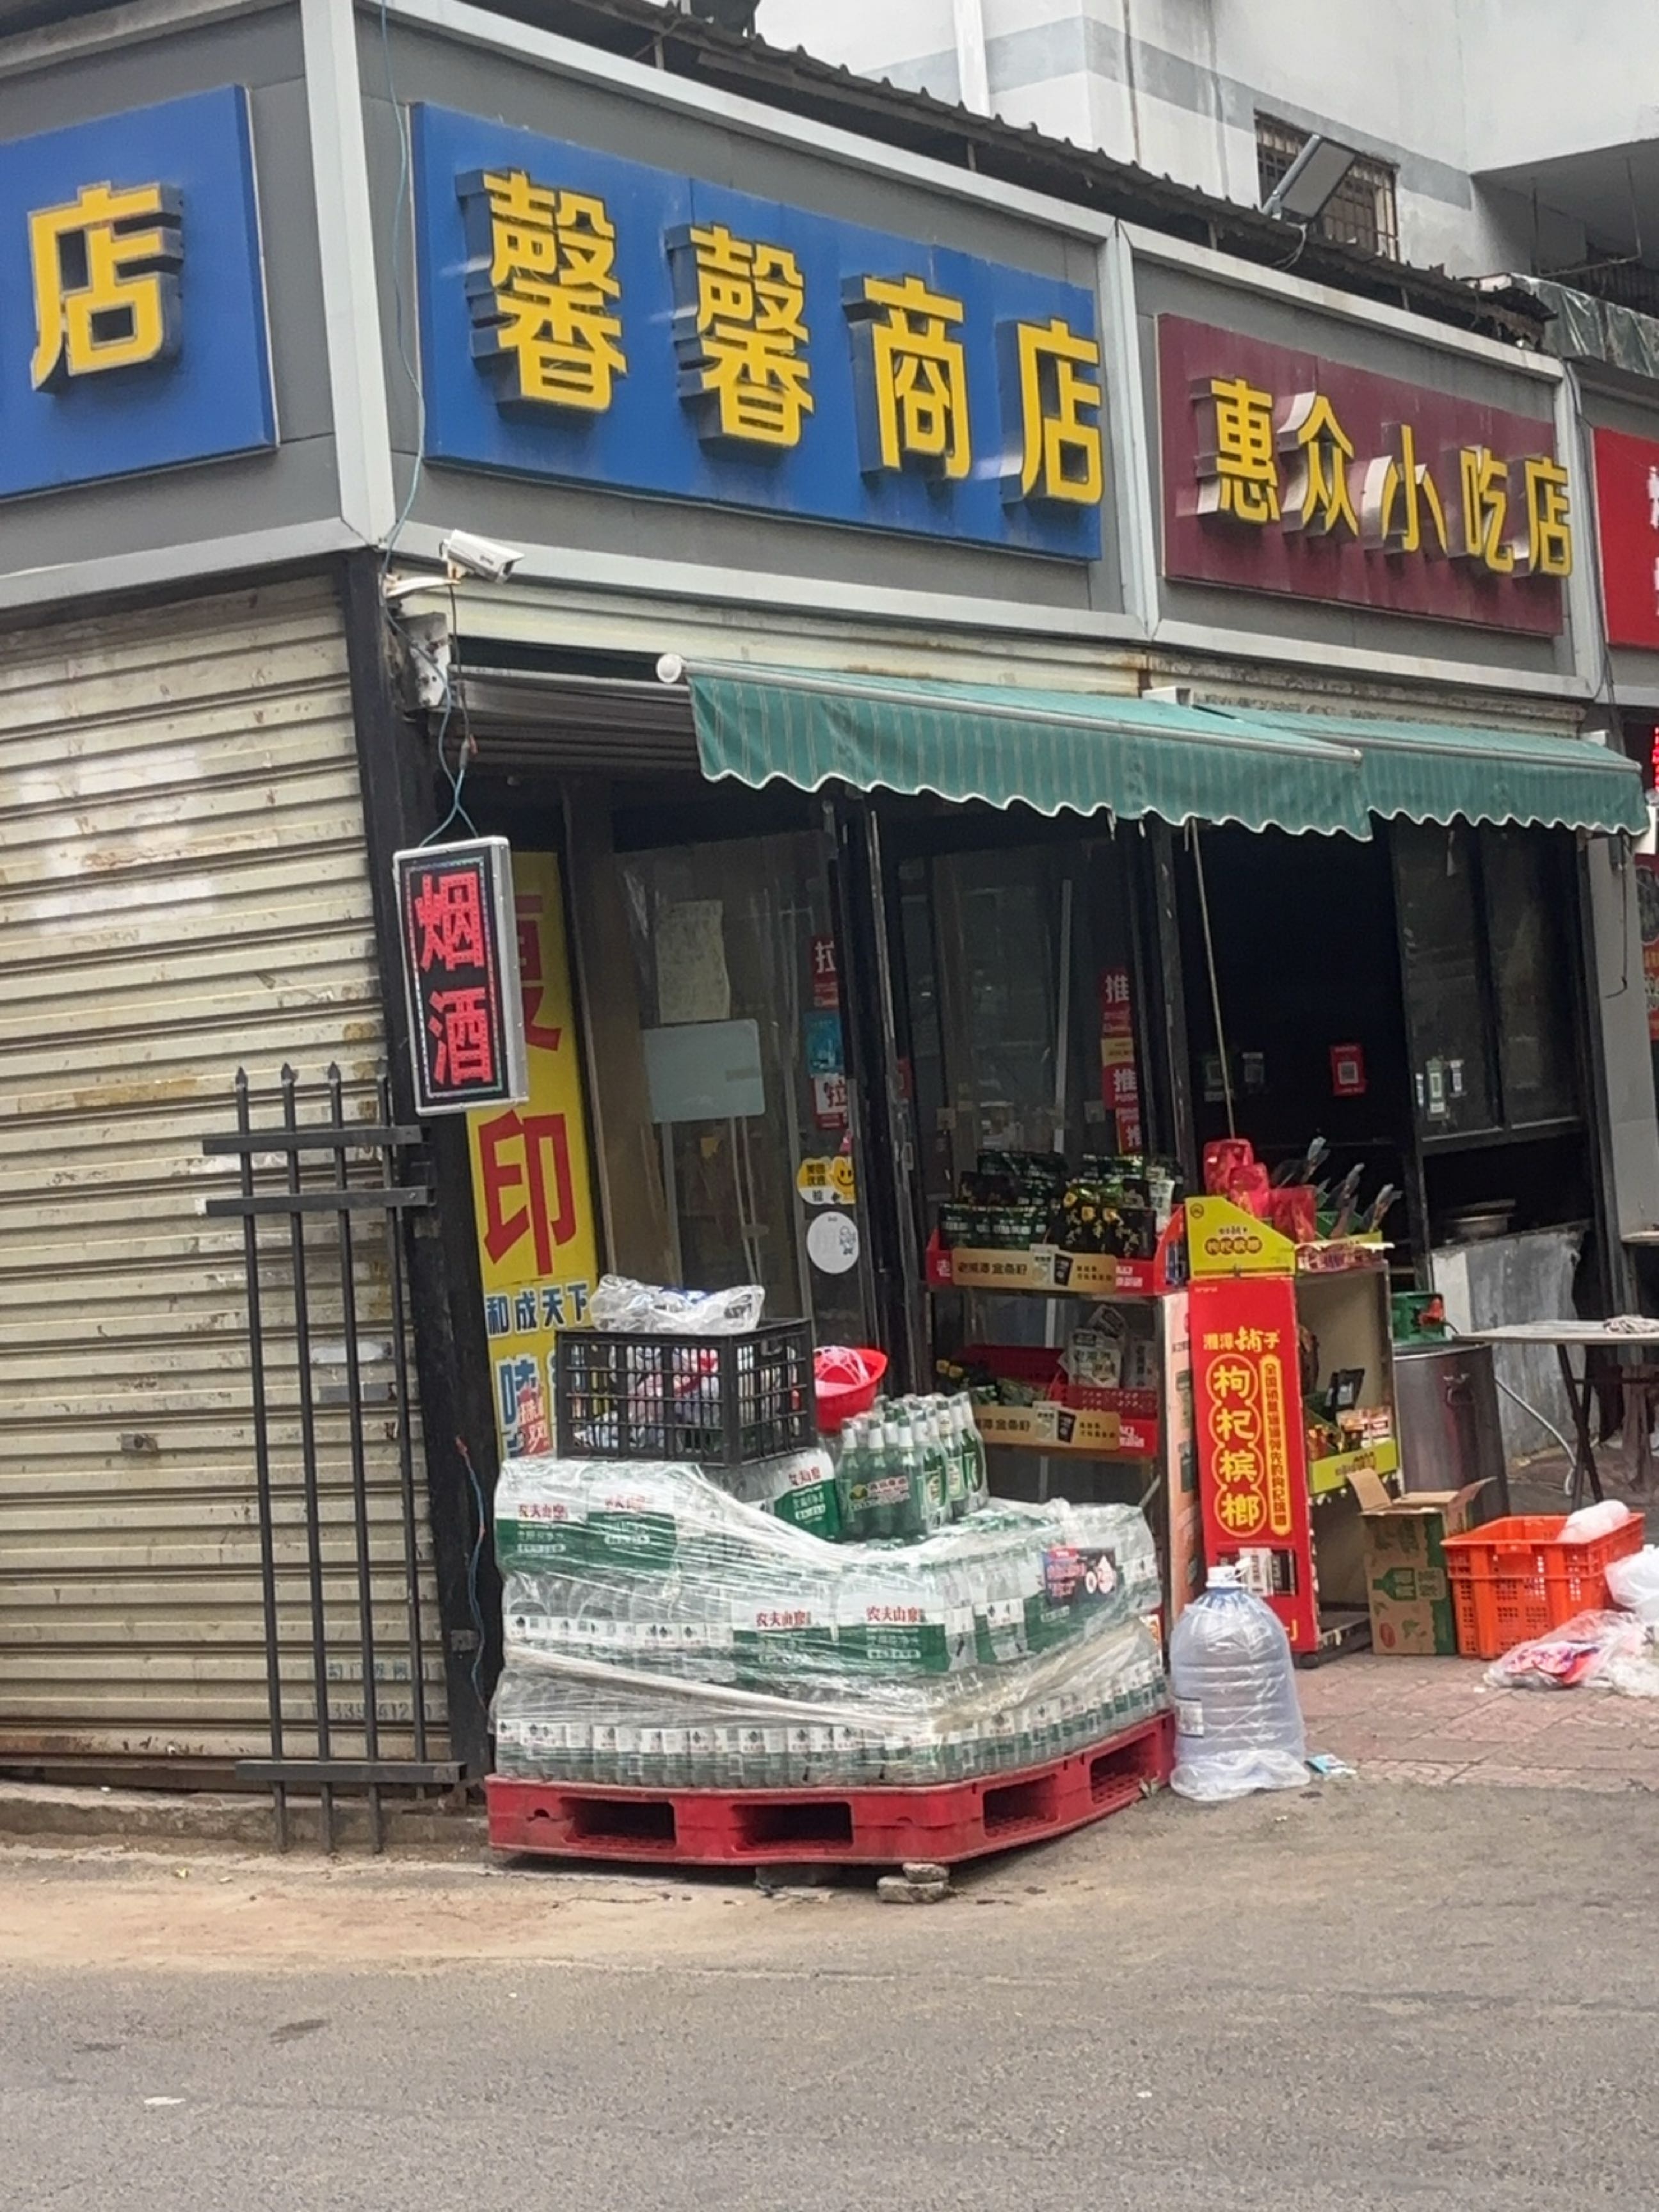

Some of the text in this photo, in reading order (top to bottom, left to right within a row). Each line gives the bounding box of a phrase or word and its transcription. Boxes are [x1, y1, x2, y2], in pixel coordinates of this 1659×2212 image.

[29, 180, 163, 392] 店
[482, 166, 1103, 504] 馨馨商店
[1210, 377, 1573, 577] 惠众小吃店
[415, 871, 493, 1086] 烟酒
[1104, 974, 1130, 1003] 推
[485, 1283, 588, 1335] 和成天下
[1212, 1364, 1262, 1528] 枸杞槟榔
